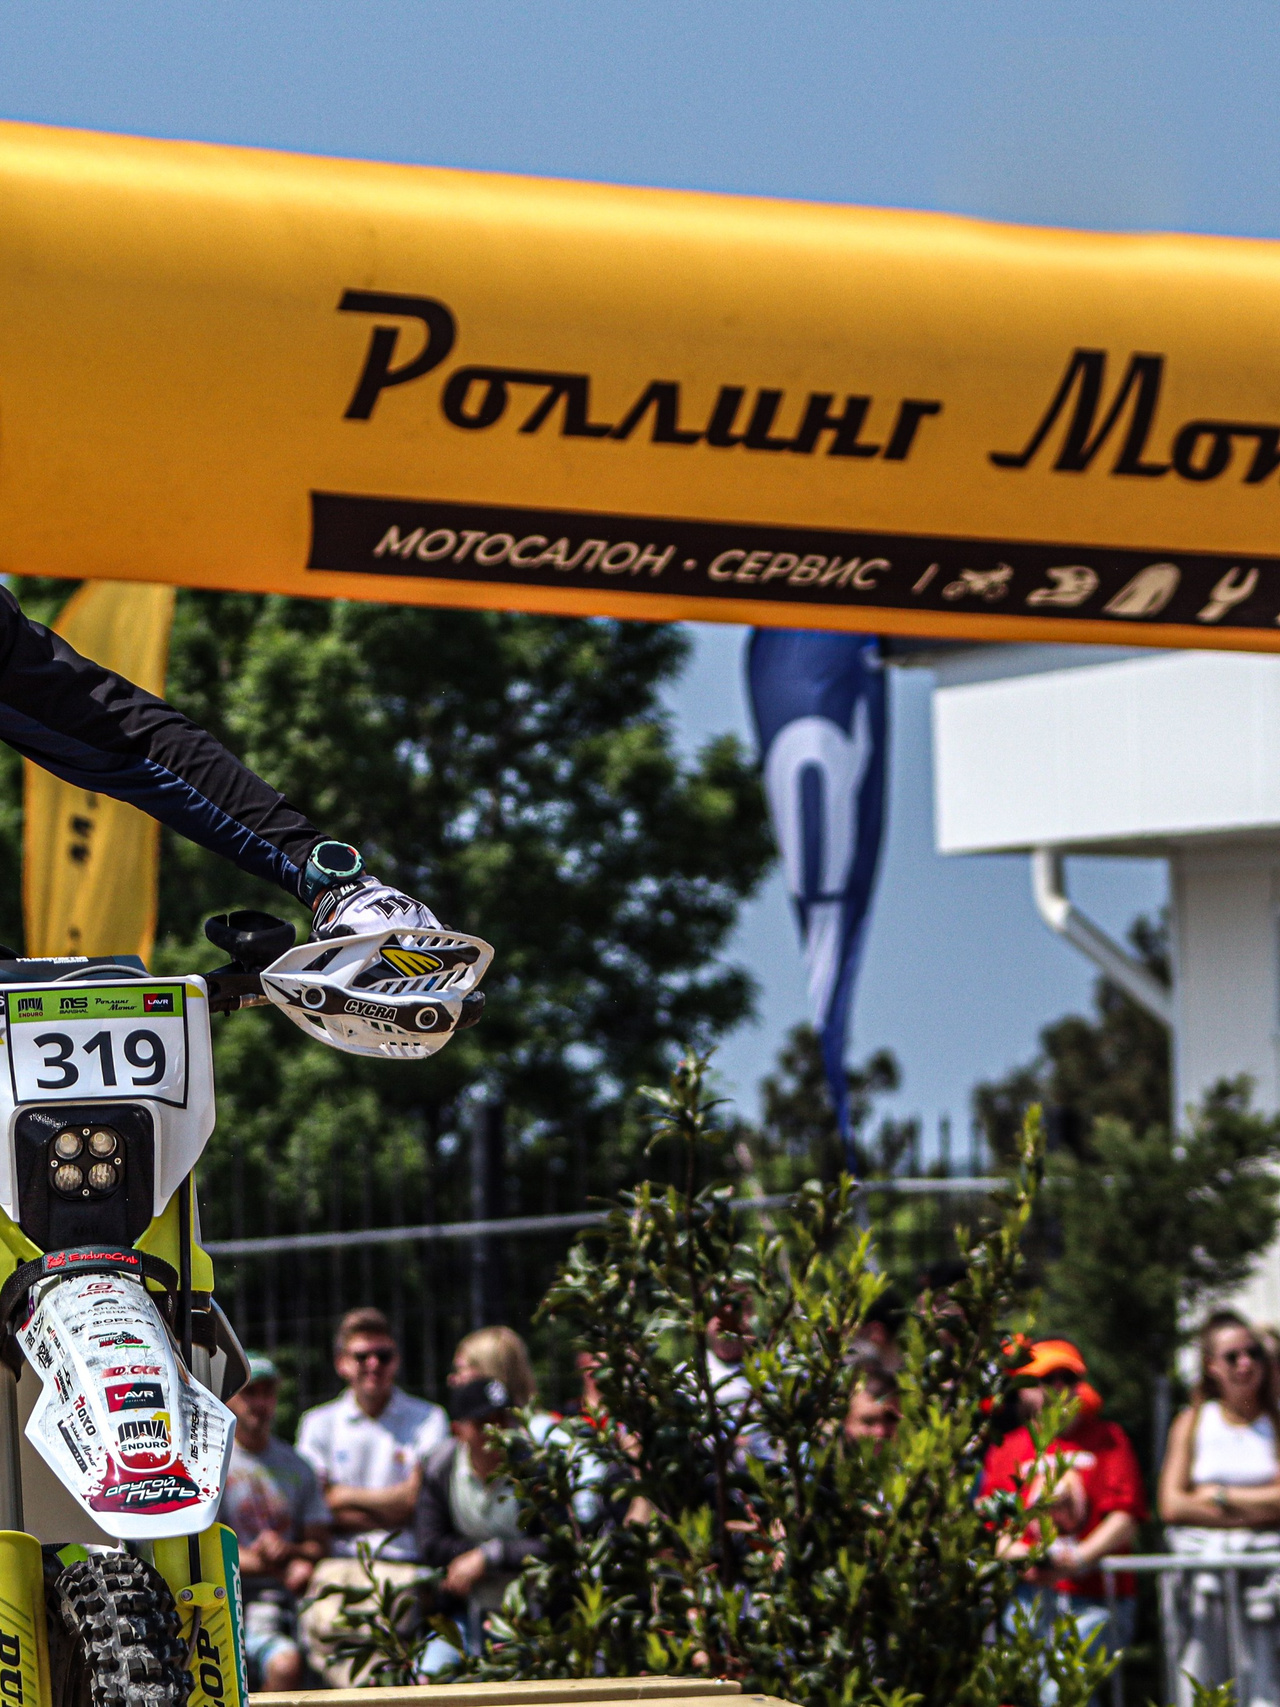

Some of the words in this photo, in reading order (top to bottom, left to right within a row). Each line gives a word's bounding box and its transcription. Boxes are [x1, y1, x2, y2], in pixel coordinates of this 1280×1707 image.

[335, 287, 943, 462] Роллинг
[373, 522, 677, 578] МОТОСАЛОН
[708, 548, 891, 592] СЕРВИС
[343, 998, 399, 1023] CYCRA
[32, 1028, 167, 1091] 319
[114, 1390, 155, 1401] LAVR
[120, 1441, 169, 1452] ENDURO
[105, 1476, 177, 1497] ДРУГОЙ
[126, 1486, 197, 1503] ПУТЬ
